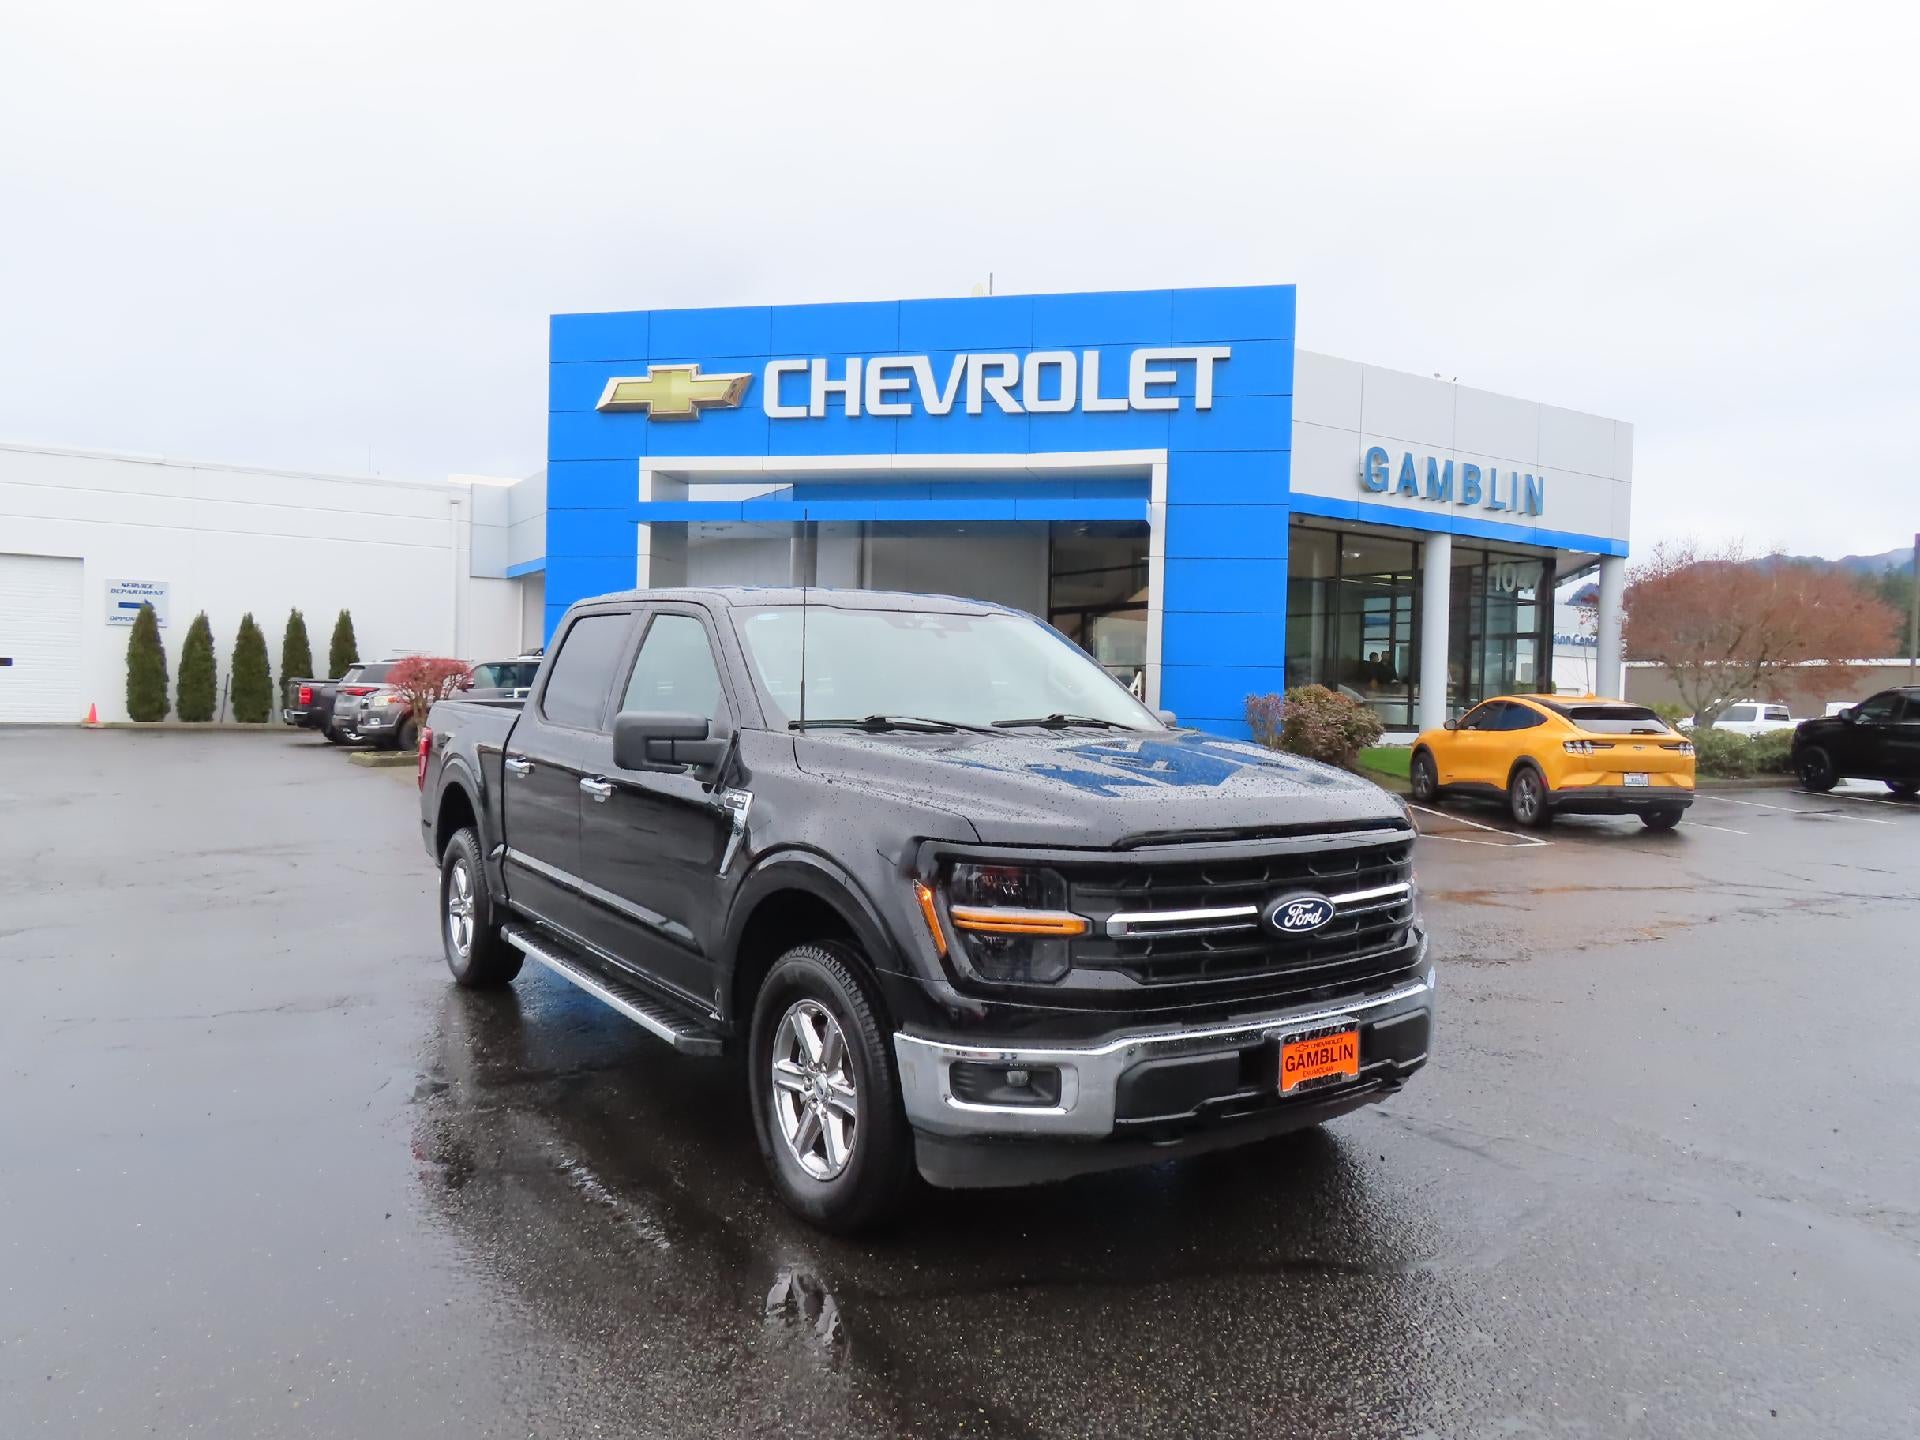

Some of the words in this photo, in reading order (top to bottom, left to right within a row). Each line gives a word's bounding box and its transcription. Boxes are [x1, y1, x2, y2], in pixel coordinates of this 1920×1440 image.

[763, 346, 1232, 419] CHEVROLET
[1361, 446, 1544, 517] GAMBLIN
[1284, 902, 1323, 927] Ford
[1285, 1044, 1353, 1072] GAMBLIN
